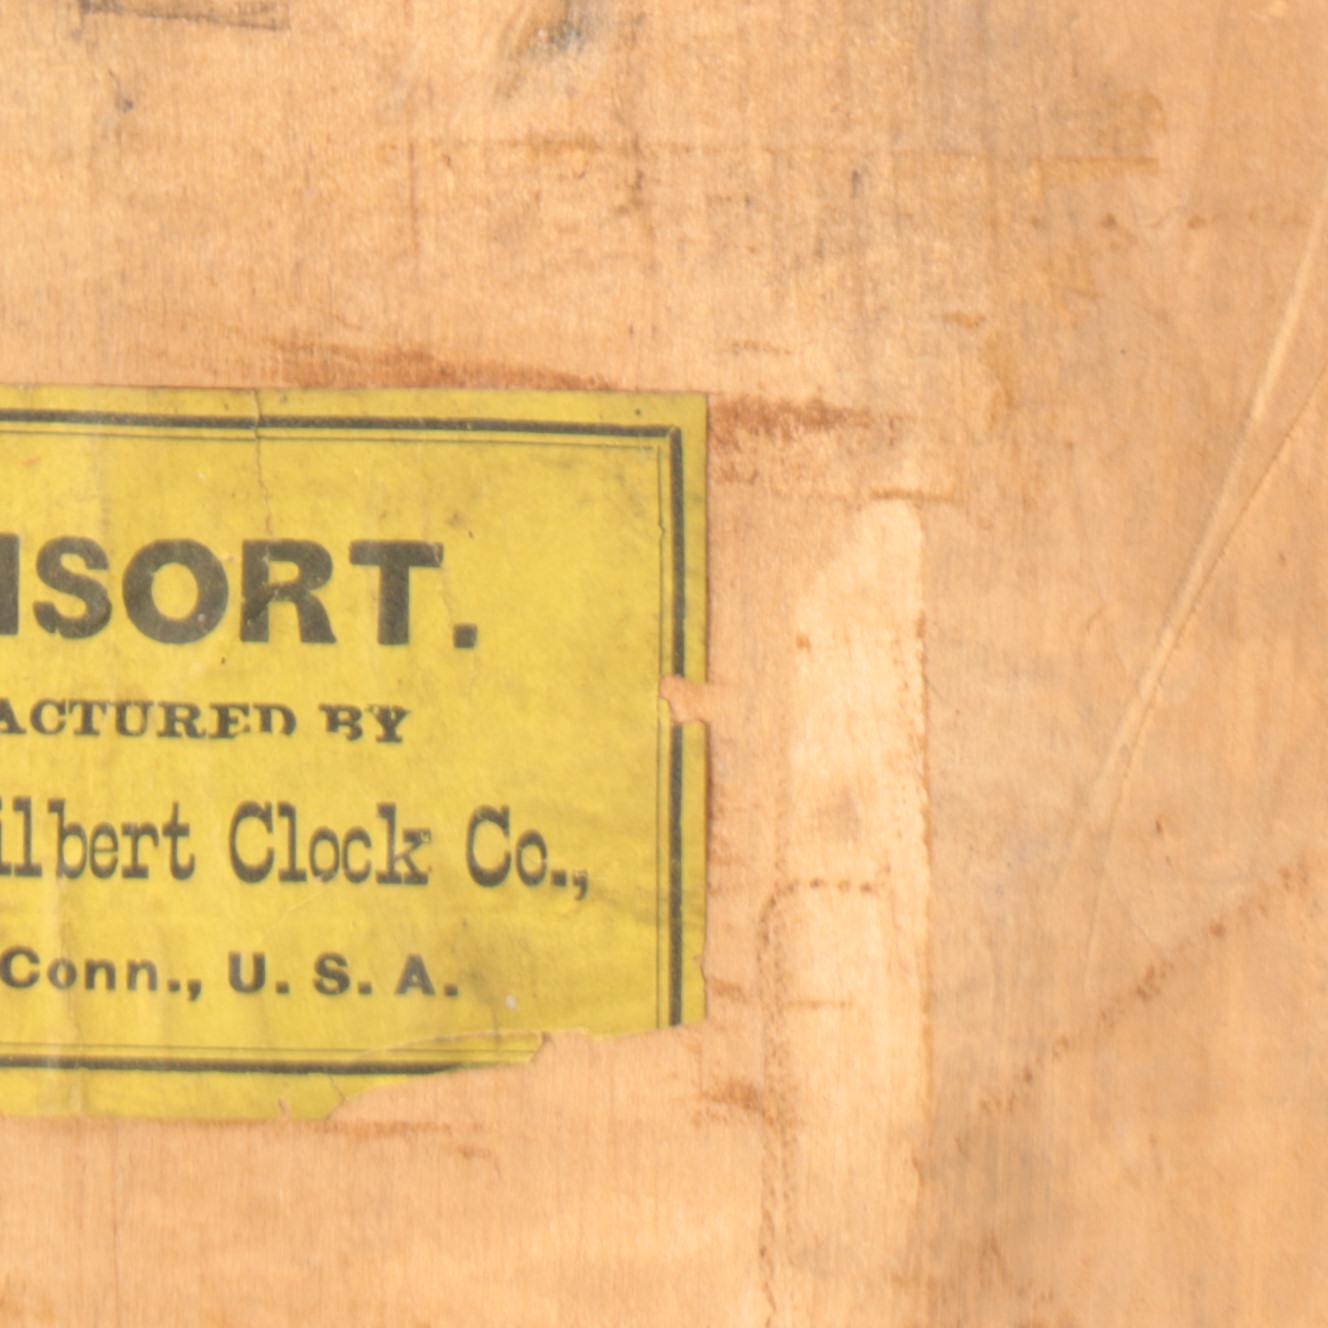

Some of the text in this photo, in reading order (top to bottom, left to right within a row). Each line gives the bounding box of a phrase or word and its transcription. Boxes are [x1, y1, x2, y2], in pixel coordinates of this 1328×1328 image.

[319, 703, 411, 744] BY
[228, 802, 430, 888] Clock
[466, 807, 590, 900] Co.,
[228, 954, 291, 996] U.
[313, 954, 373, 998] S.
[396, 955, 460, 999] A.
